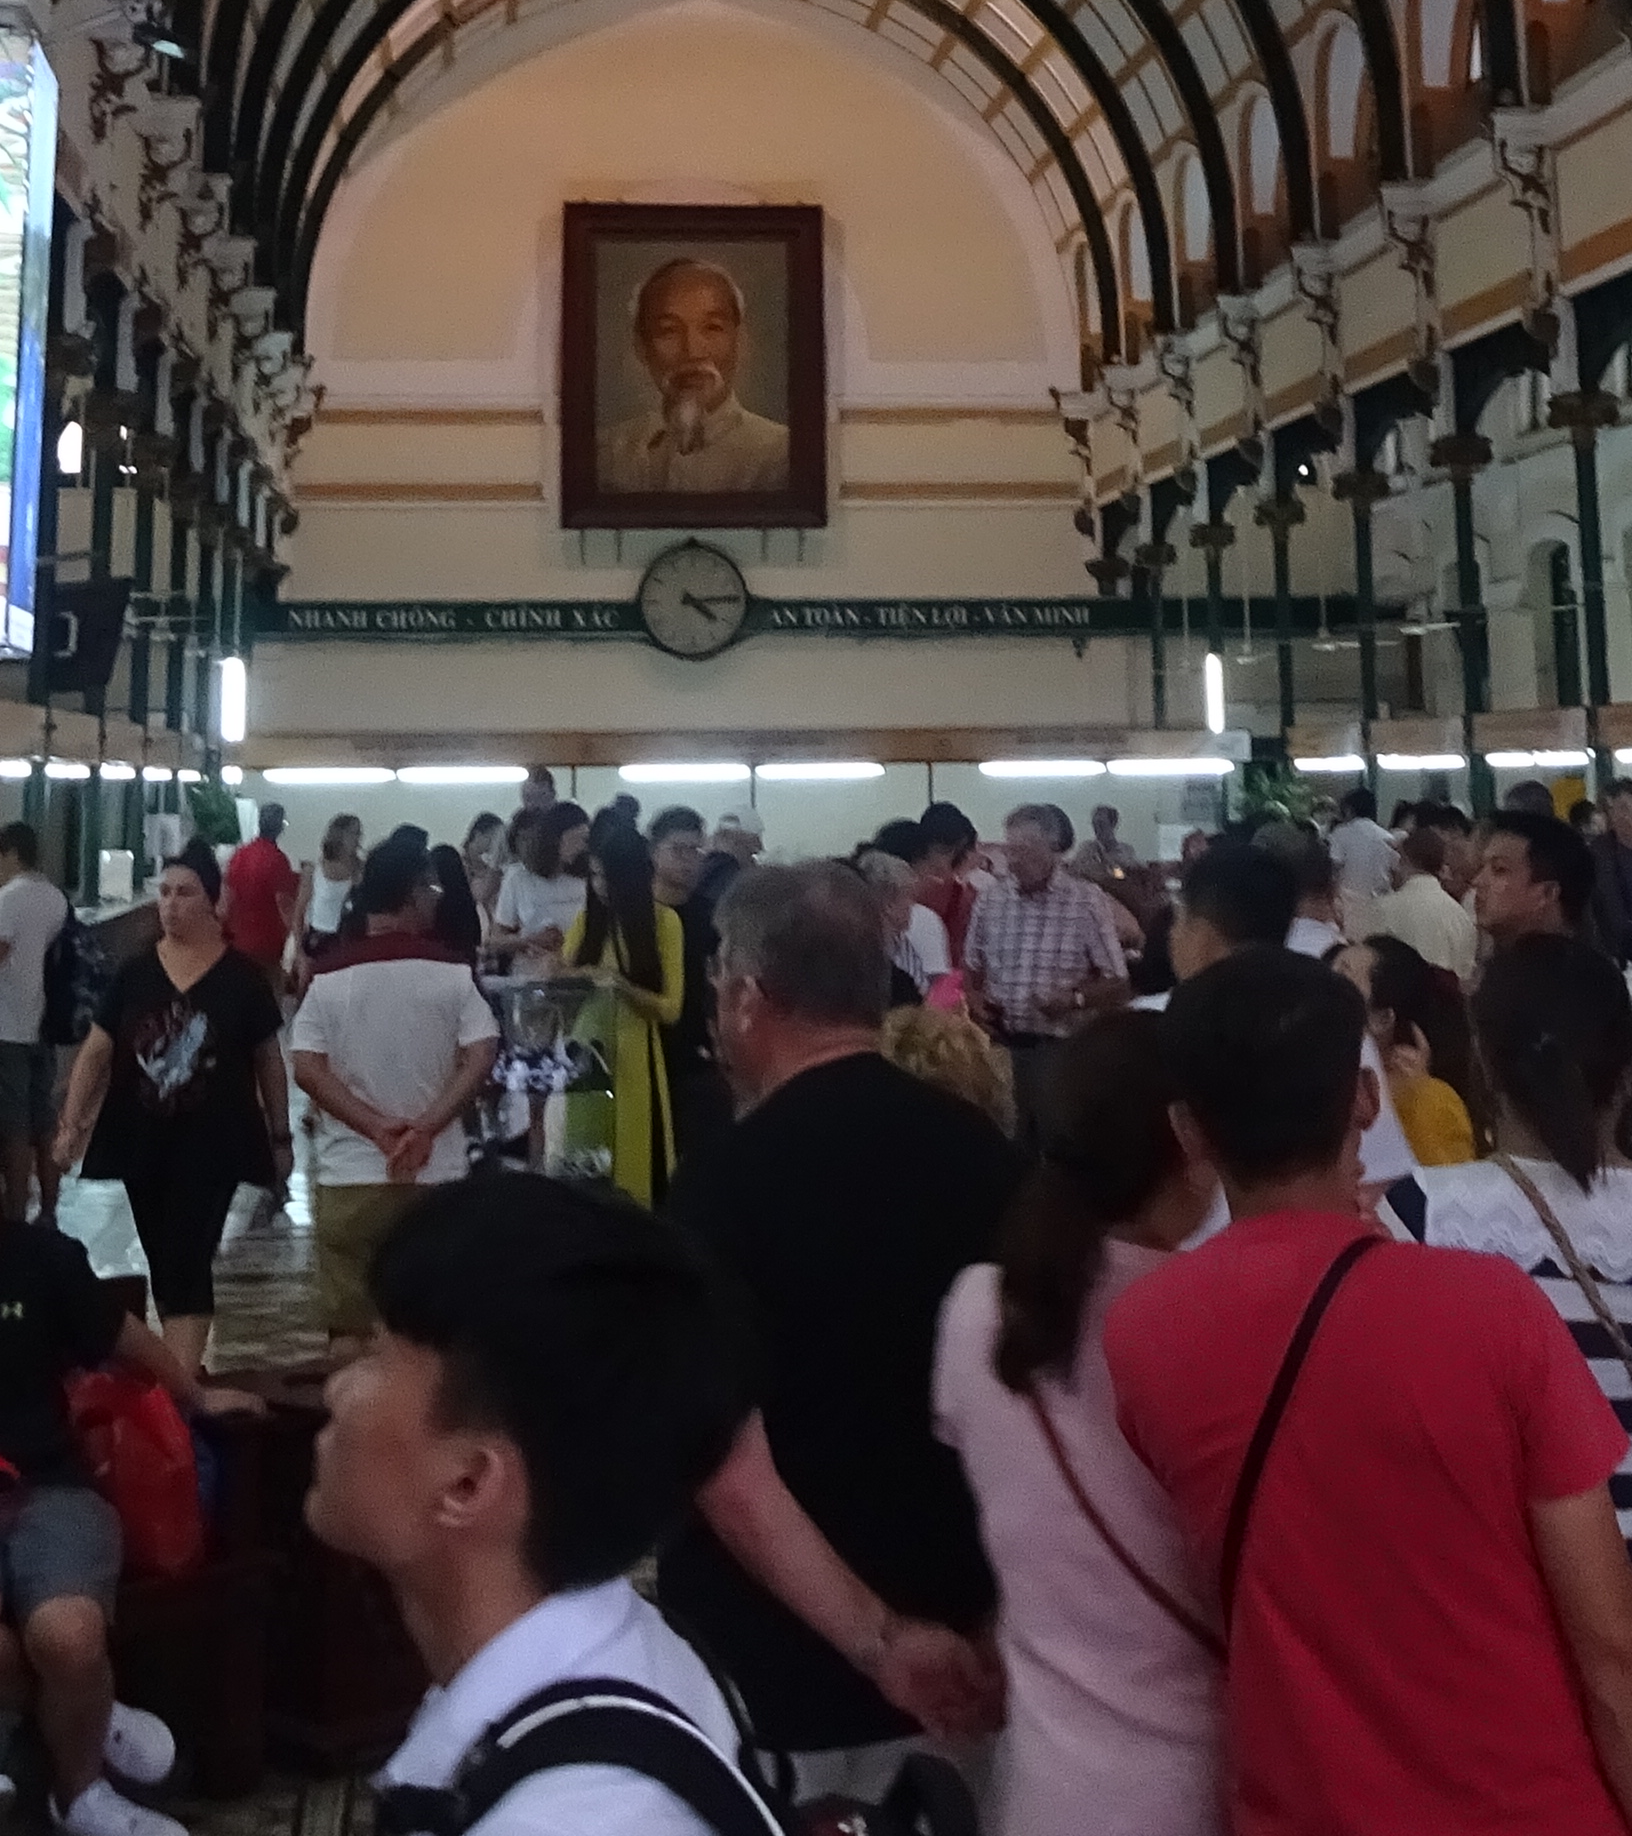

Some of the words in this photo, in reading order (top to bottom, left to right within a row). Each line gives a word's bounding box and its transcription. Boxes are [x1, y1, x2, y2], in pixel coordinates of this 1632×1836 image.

[288, 608, 367, 628] NHANH
[772, 606, 797, 626] AN
[1032, 606, 1090, 626] MINH
